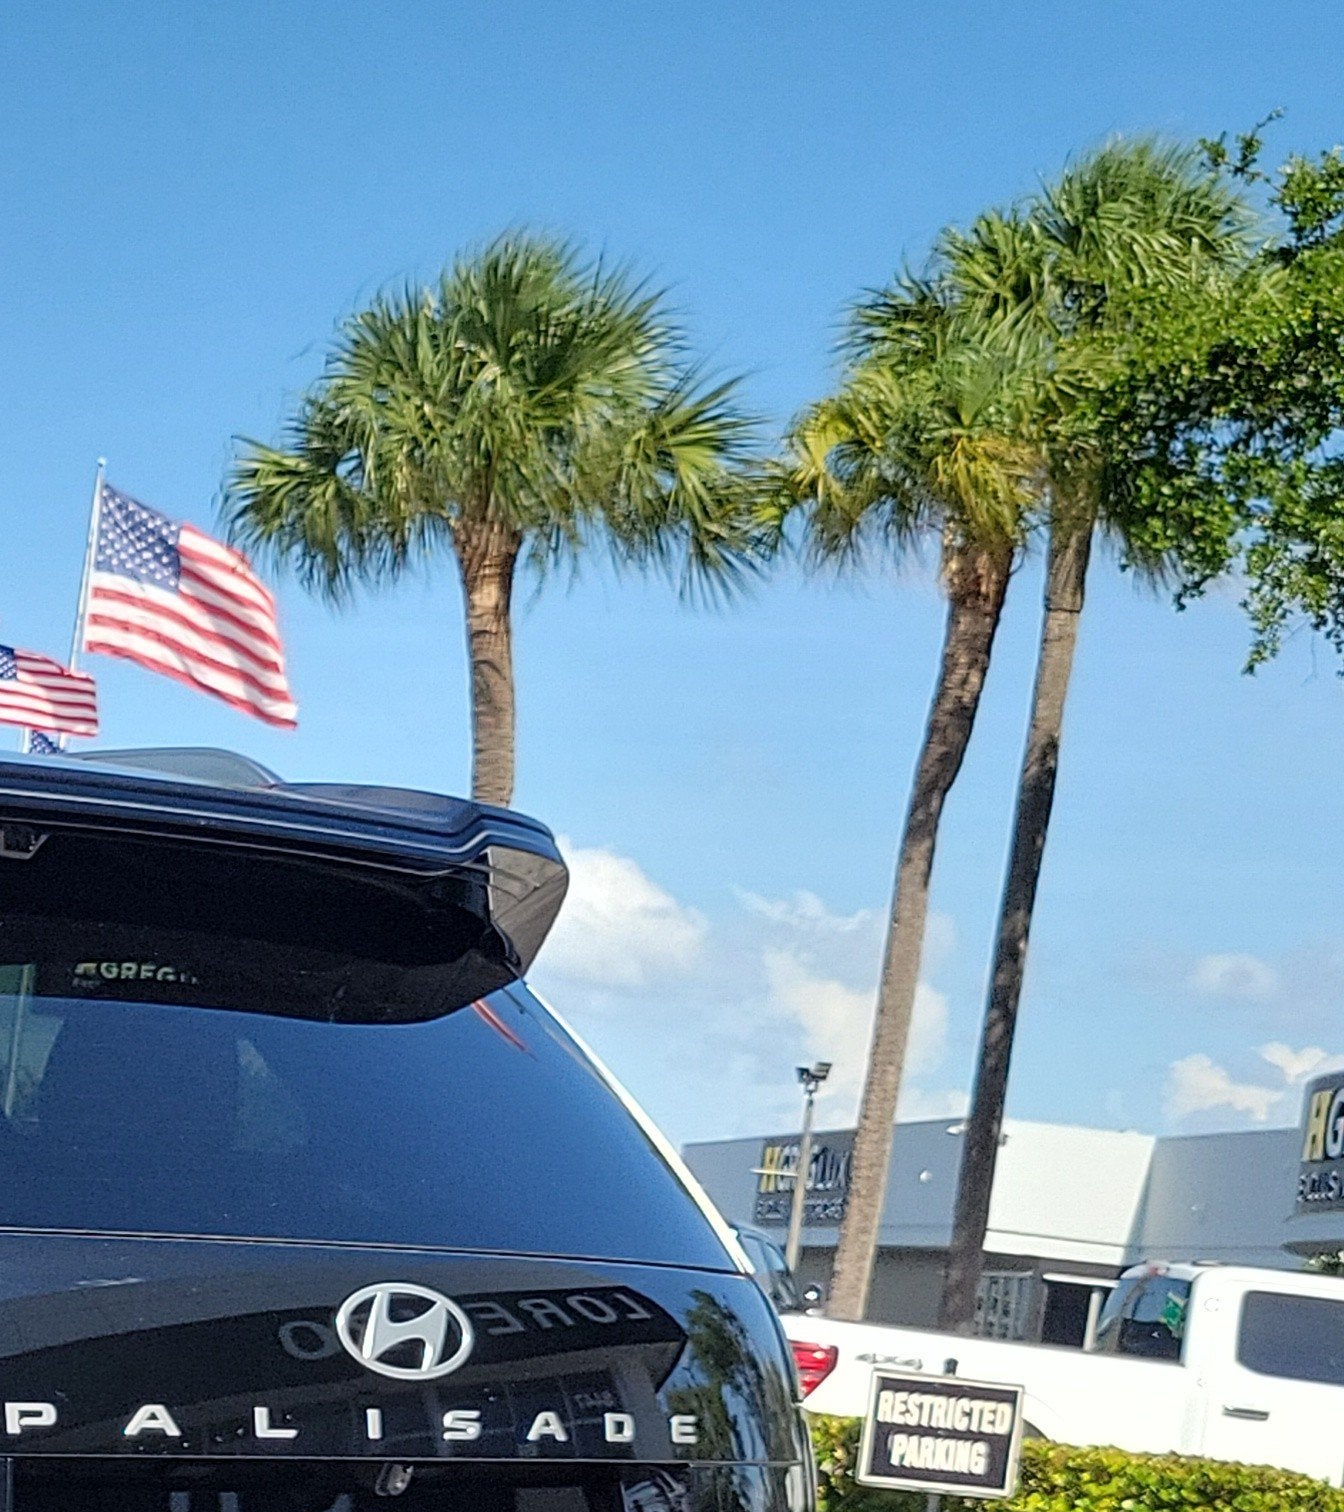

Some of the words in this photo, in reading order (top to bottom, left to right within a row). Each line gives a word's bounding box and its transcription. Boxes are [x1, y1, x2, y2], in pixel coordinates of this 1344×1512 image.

[4, 1402, 699, 1445] PALISADE
[876, 1390, 1014, 1436] RESTRICTED
[889, 1432, 991, 1476] PARKING
